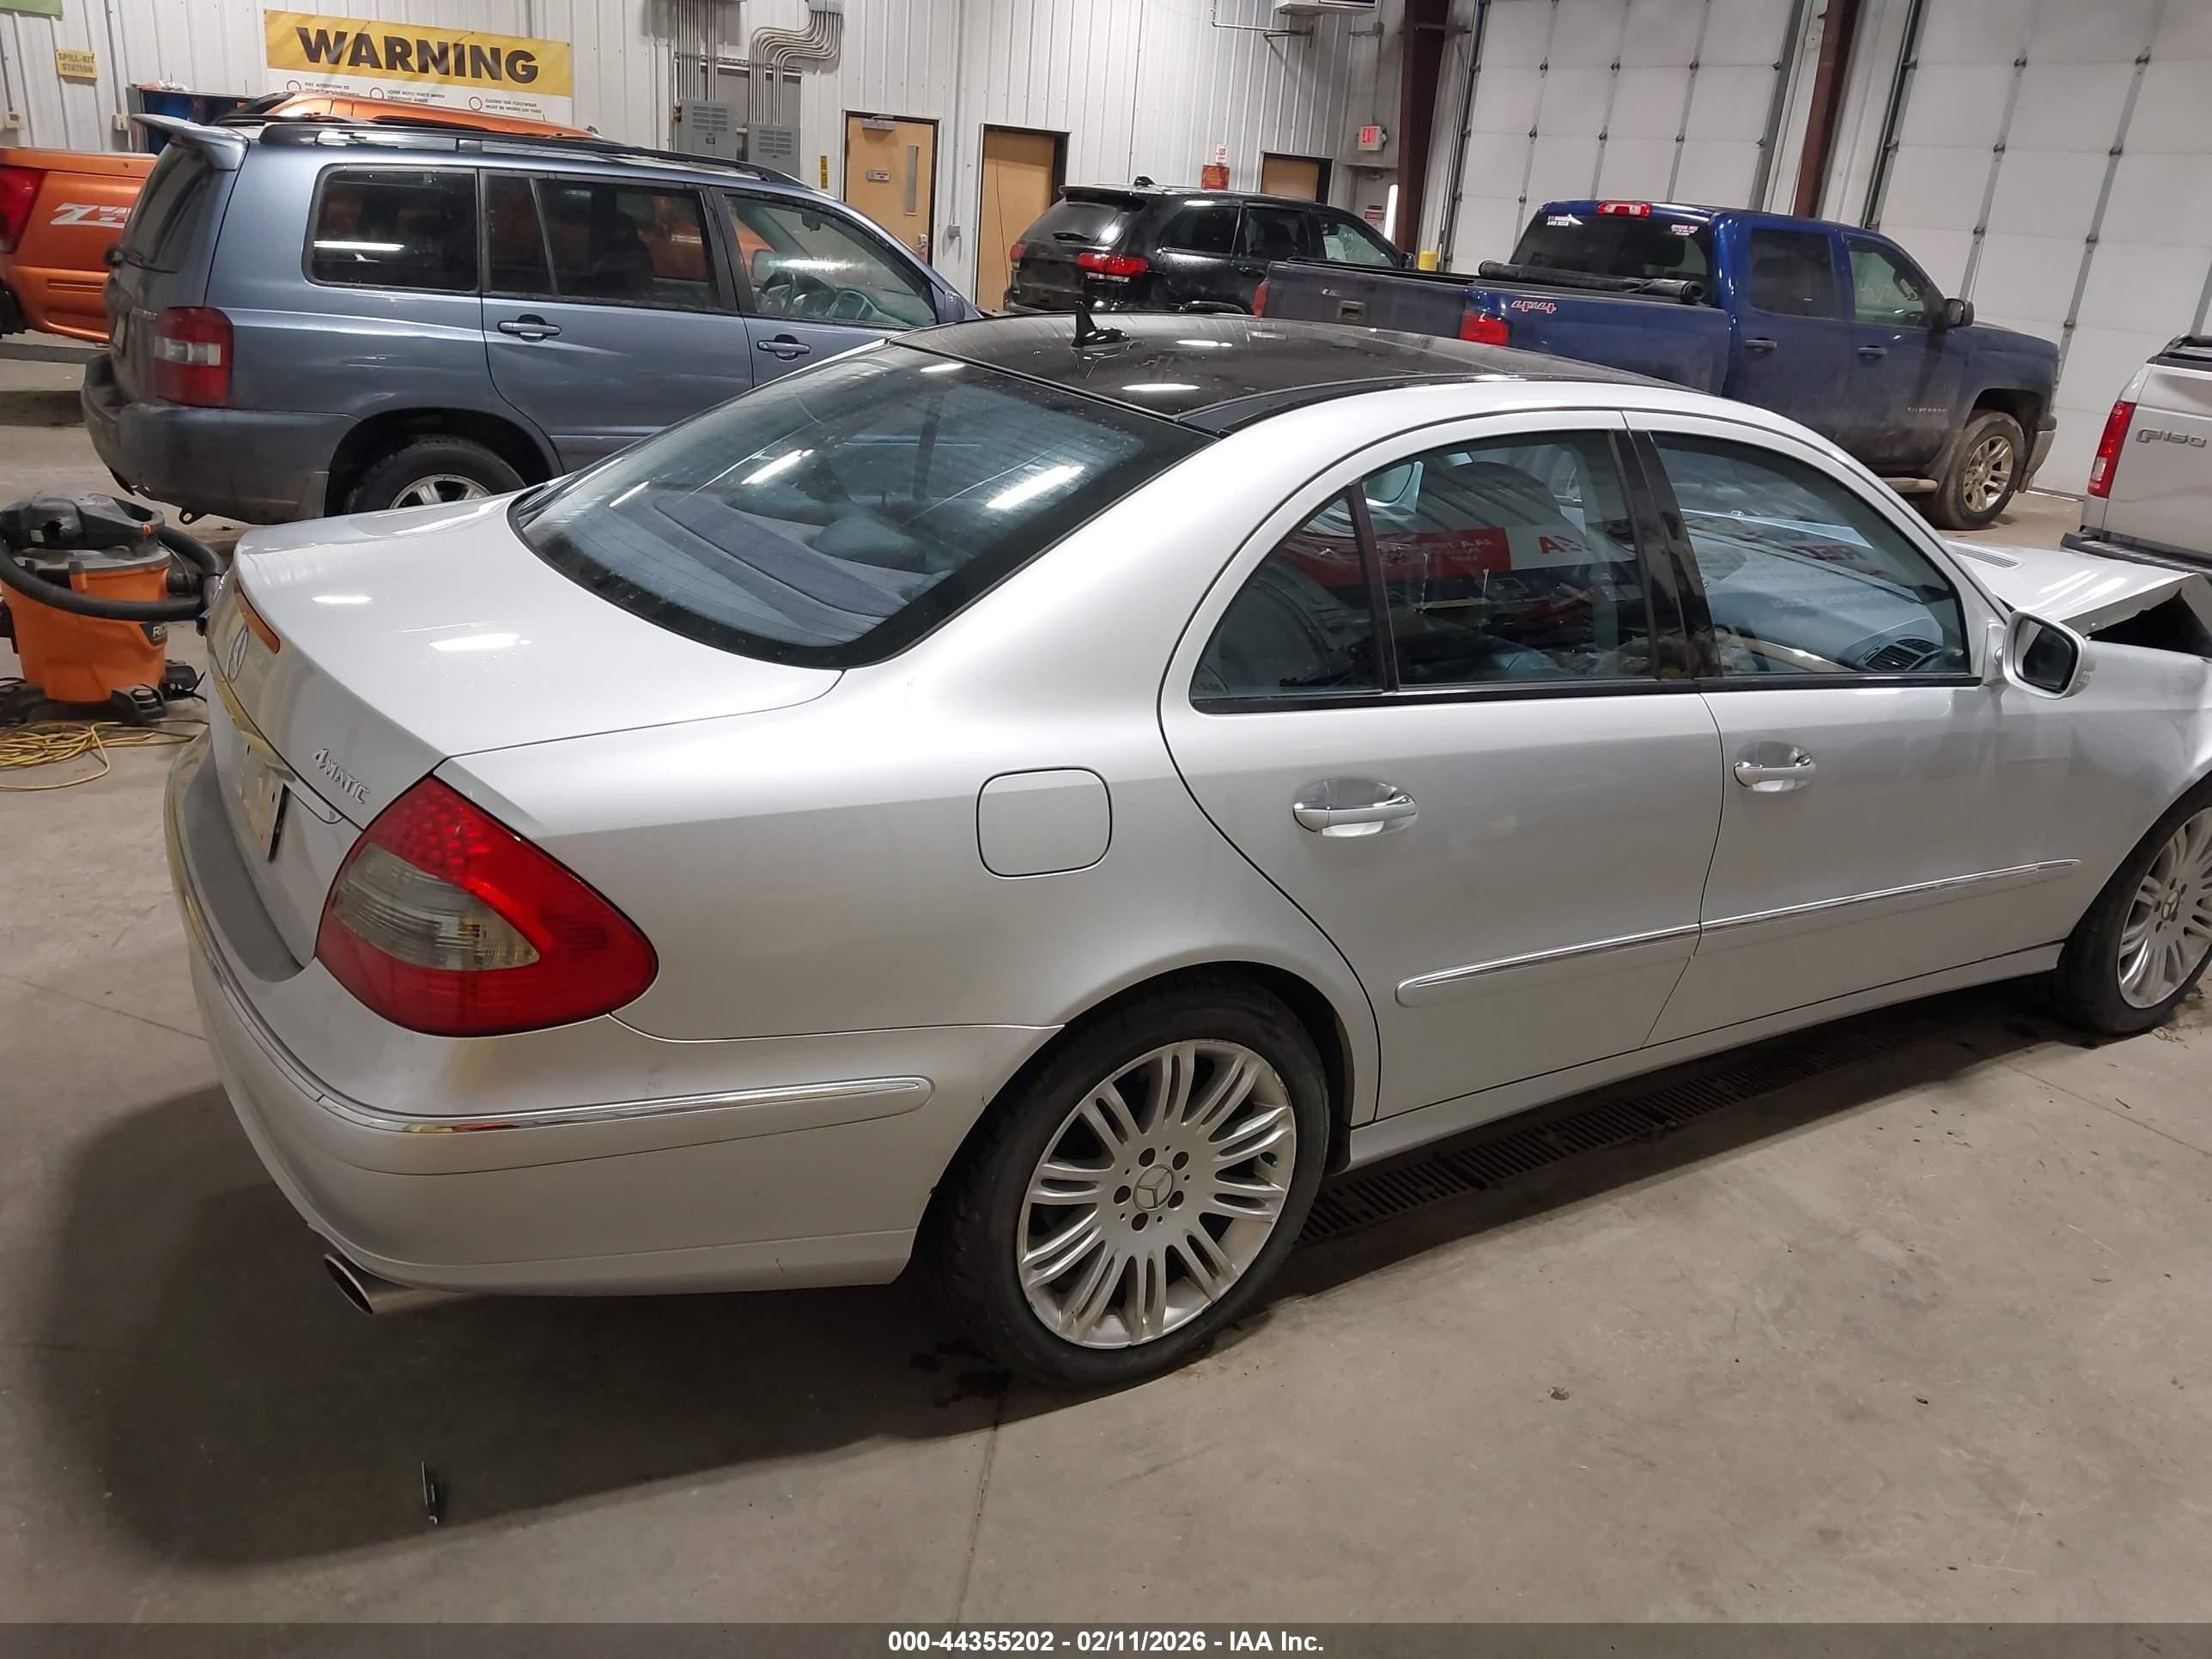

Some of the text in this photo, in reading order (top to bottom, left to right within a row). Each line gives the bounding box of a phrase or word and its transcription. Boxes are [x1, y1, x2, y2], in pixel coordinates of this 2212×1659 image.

[58, 52, 94, 64] SPILL-KIT
[62, 63, 94, 73] STATION
[295, 26, 538, 84] WARNING
[313, 748, 370, 805] 4MATIC
